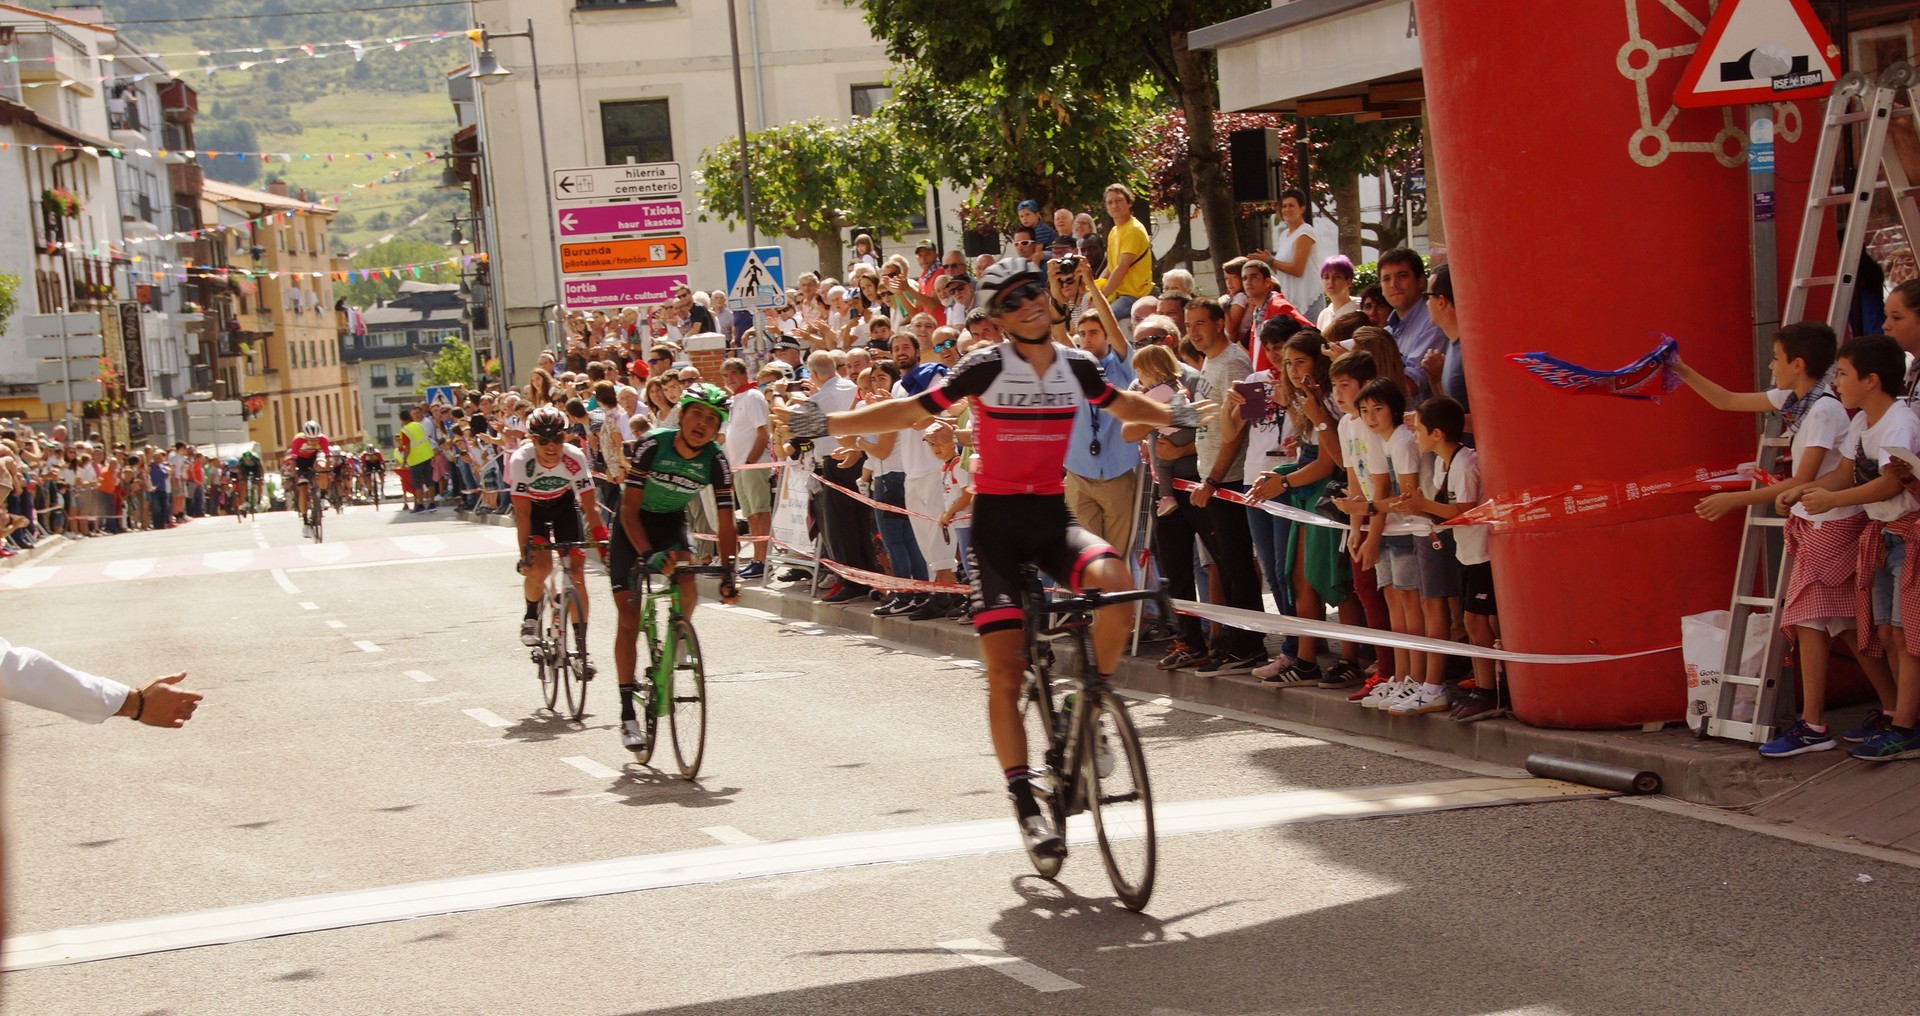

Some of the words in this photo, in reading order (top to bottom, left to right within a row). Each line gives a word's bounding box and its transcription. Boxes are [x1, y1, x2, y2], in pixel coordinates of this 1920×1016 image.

[625, 167, 666, 178] hilerria
[615, 181, 678, 194] cementerio
[641, 204, 681, 216] Txioka
[617, 220, 640, 229] haur
[643, 217, 682, 227] ikastola
[563, 246, 612, 257] Burunda
[566, 283, 597, 293] Iortia
[997, 392, 1075, 407] LIZARTE
[1641, 481, 1675, 492] Gobierno
